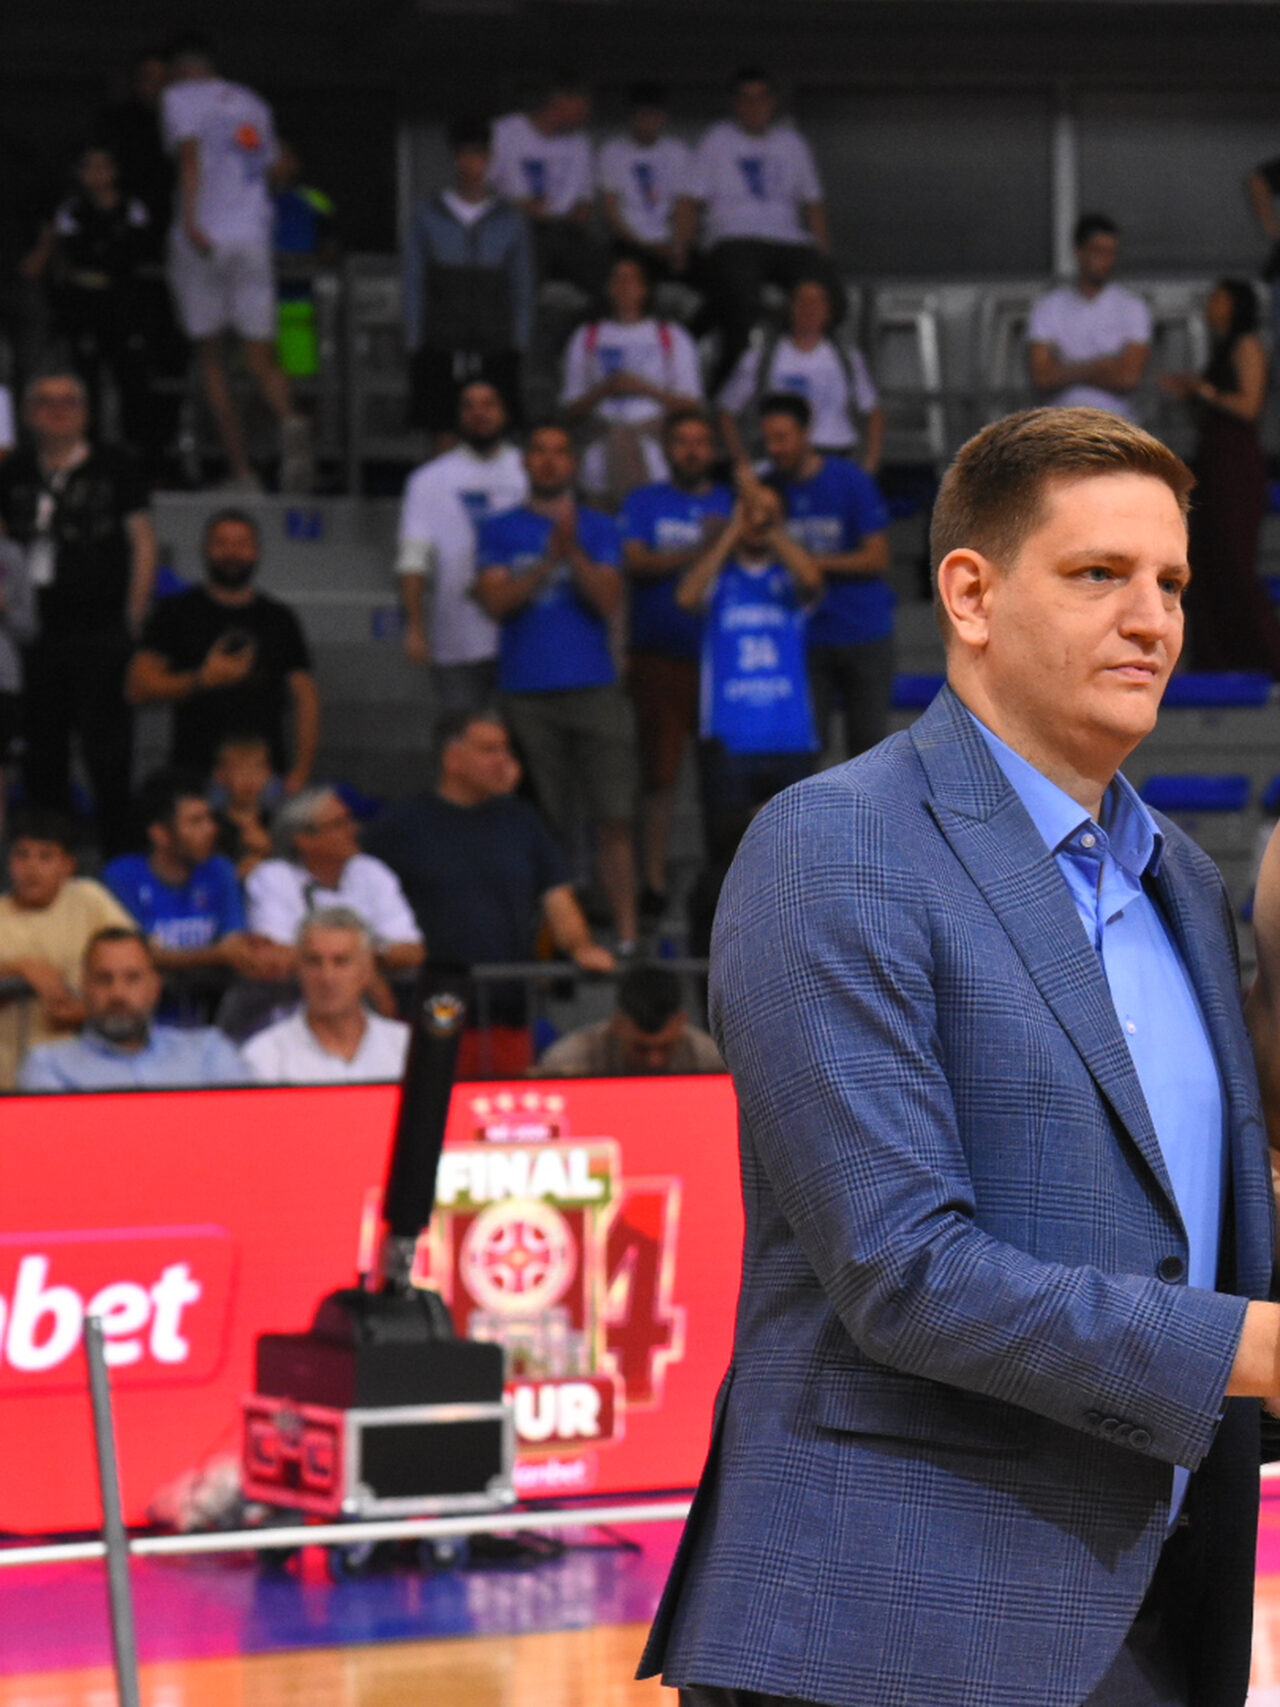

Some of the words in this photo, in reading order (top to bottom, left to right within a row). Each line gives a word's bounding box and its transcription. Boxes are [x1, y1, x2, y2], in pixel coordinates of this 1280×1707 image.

[436, 1149, 603, 1203] FINAL
[0, 1254, 201, 1372] bet
[504, 1382, 601, 1440] UR
